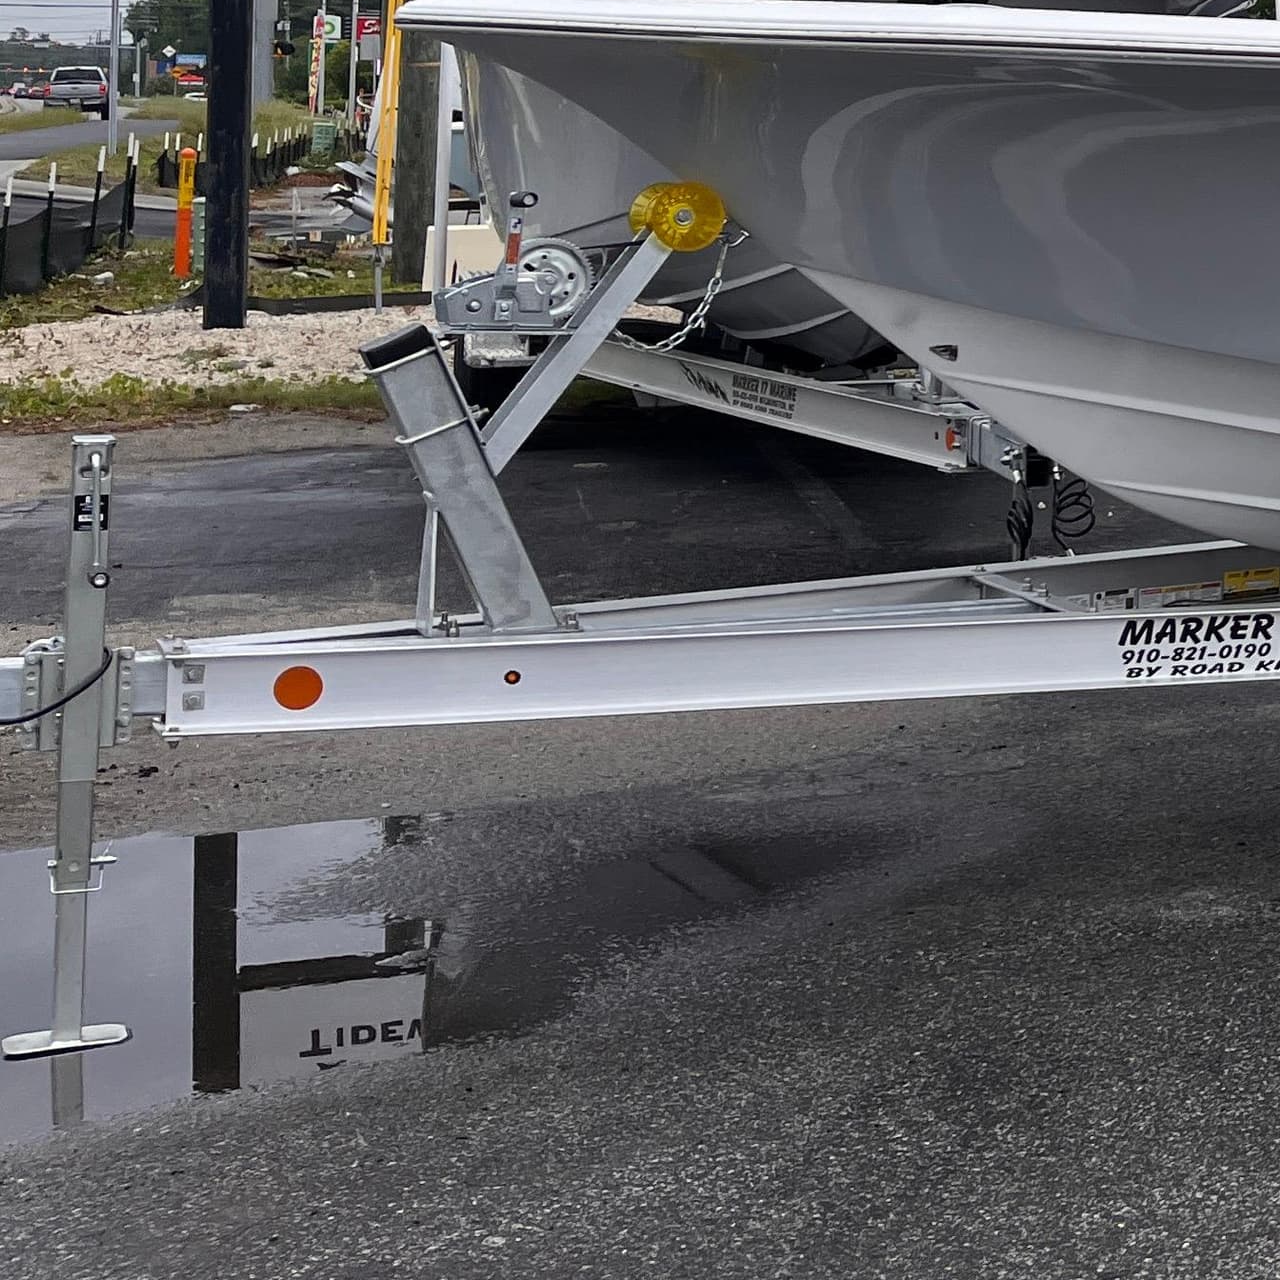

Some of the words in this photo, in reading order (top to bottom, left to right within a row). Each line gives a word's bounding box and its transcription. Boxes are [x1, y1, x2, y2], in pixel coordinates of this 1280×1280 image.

[1118, 612, 1275, 647] MARKER
[1121, 642, 1272, 665] 910-821-0190
[1125, 665, 1161, 680] BY
[1170, 660, 1245, 677] ROAD
